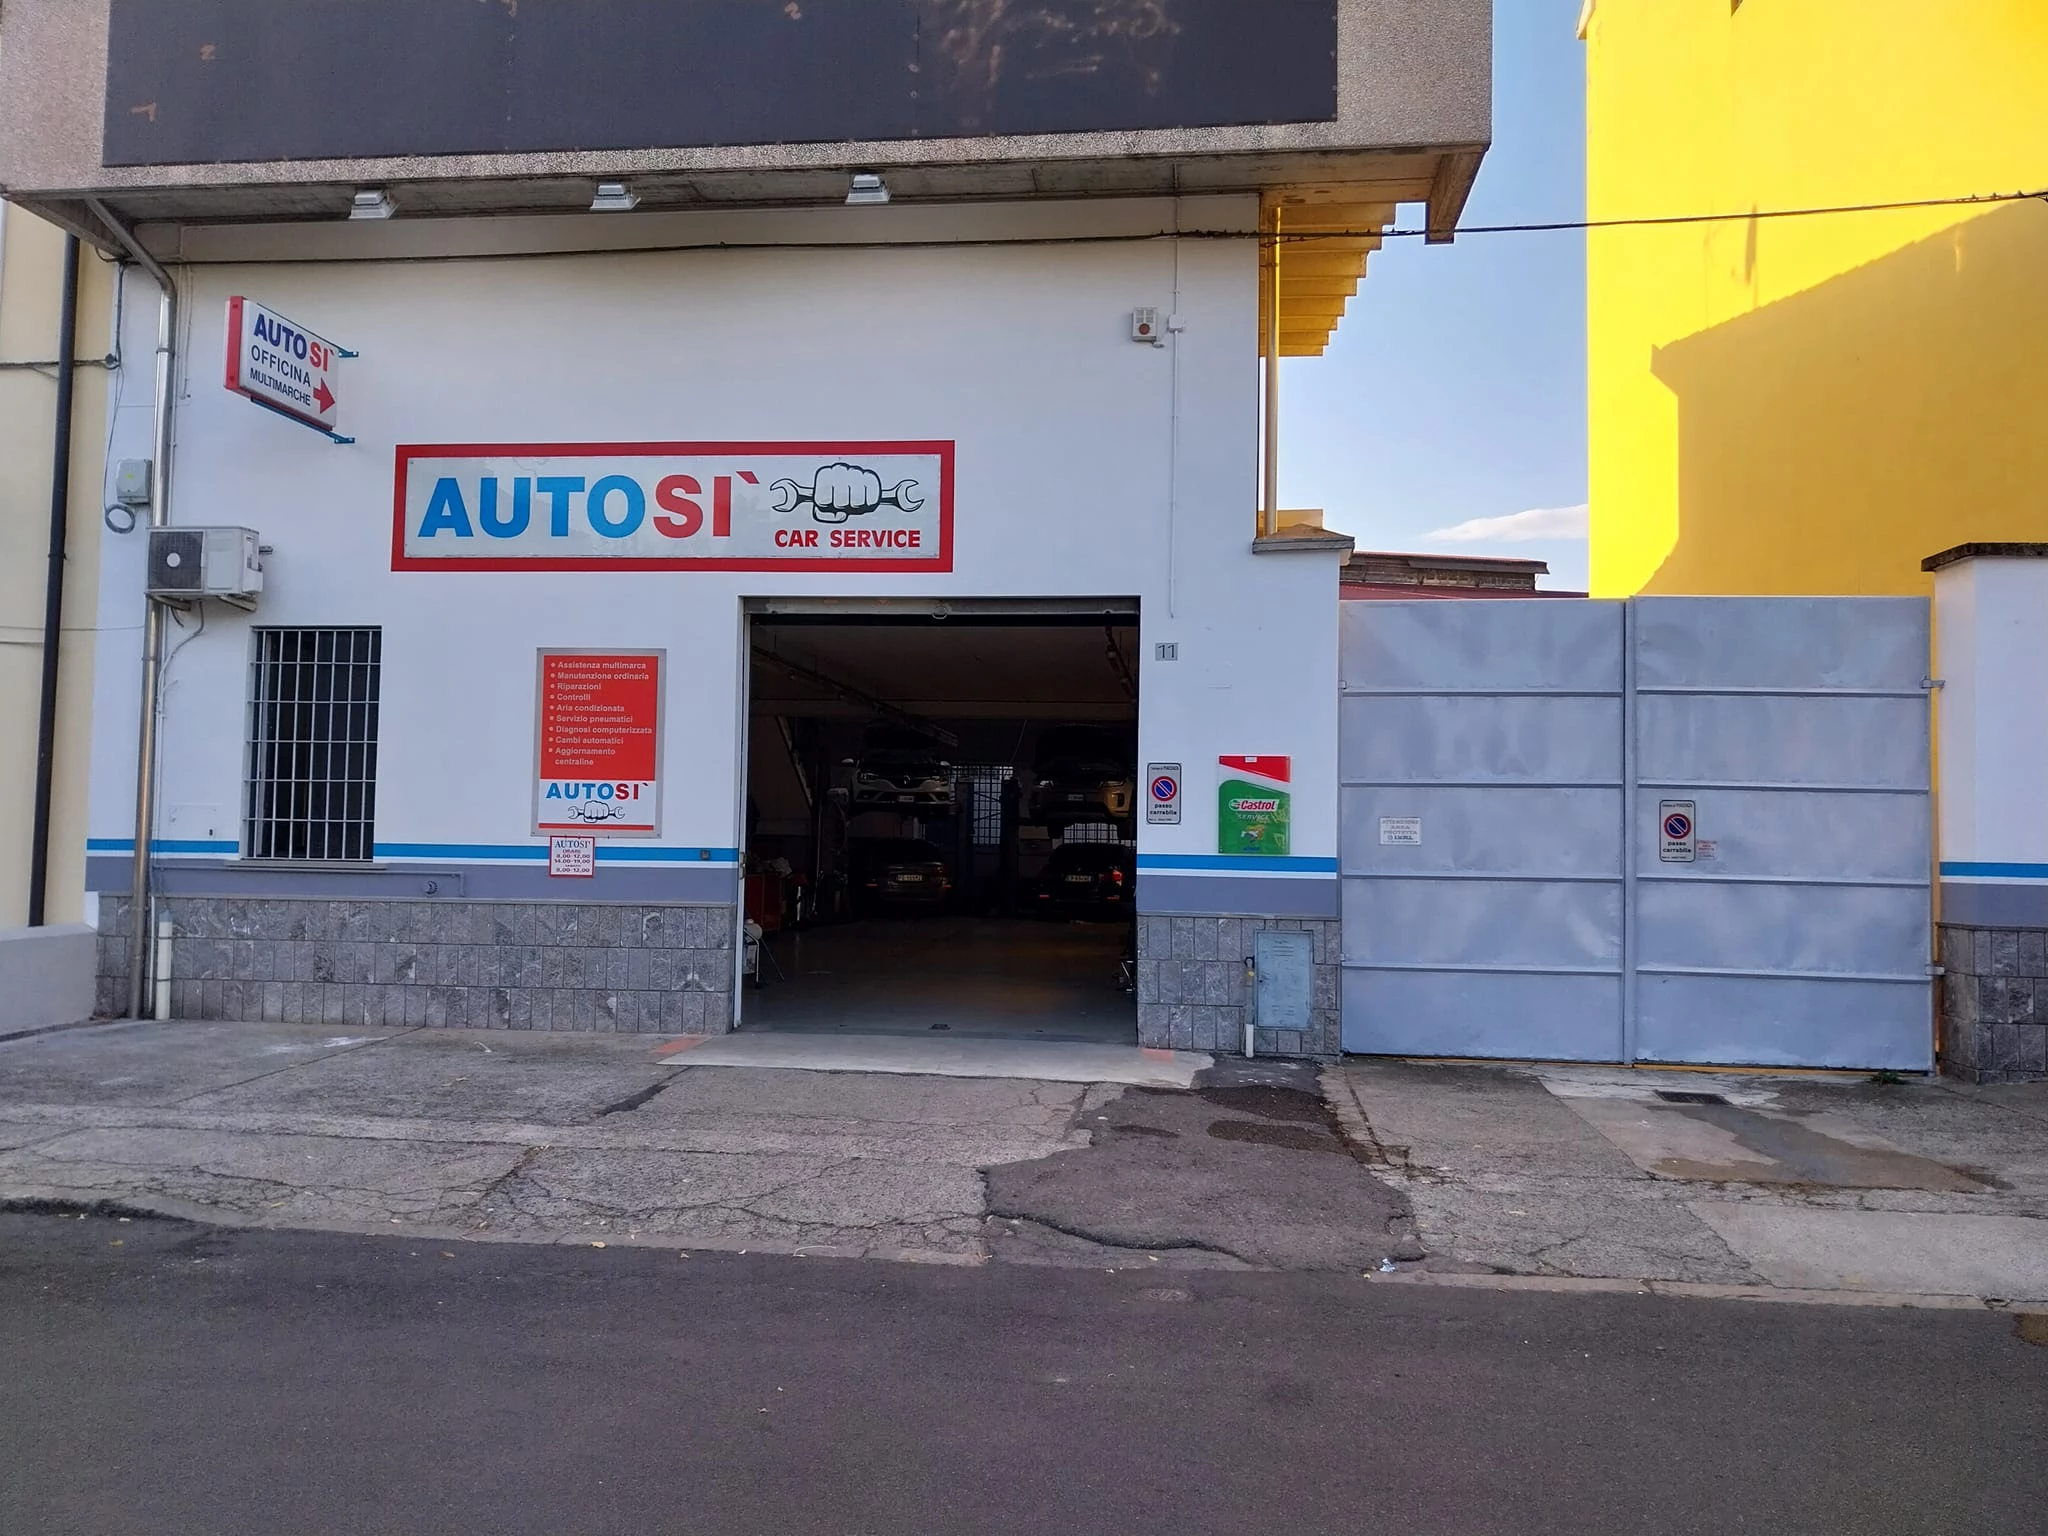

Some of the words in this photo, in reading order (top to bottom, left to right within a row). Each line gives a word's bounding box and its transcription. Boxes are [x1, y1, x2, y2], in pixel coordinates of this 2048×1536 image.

[251, 344, 311, 387] OFFICINA
[250, 367, 311, 407] MULTIMARCHE
[774, 529, 819, 548] CAR
[829, 529, 921, 548] SERVICE
[1158, 644, 1176, 660] 11
[557, 661, 600, 670] Assistenza
[602, 662, 646, 670] multimarca
[557, 671, 612, 680] Manutenzione
[613, 672, 649, 680] ordinaria
[557, 682, 602, 692] Riparazioni
[556, 693, 591, 701] Controlli
[556, 704, 573, 712] Aria
[574, 704, 625, 713] condizionata
[556, 714, 588, 723] Servizio
[589, 715, 633, 724] pneumatici
[556, 725, 591, 735] Diagnosi
[592, 726, 653, 735] computerizzata
[555, 736, 581, 745] Cambi
[582, 737, 624, 745] automatici
[555, 747, 616, 756] Aggiornamento
[554, 758, 594, 766] centraline
[1241, 799, 1276, 810] Castrol
